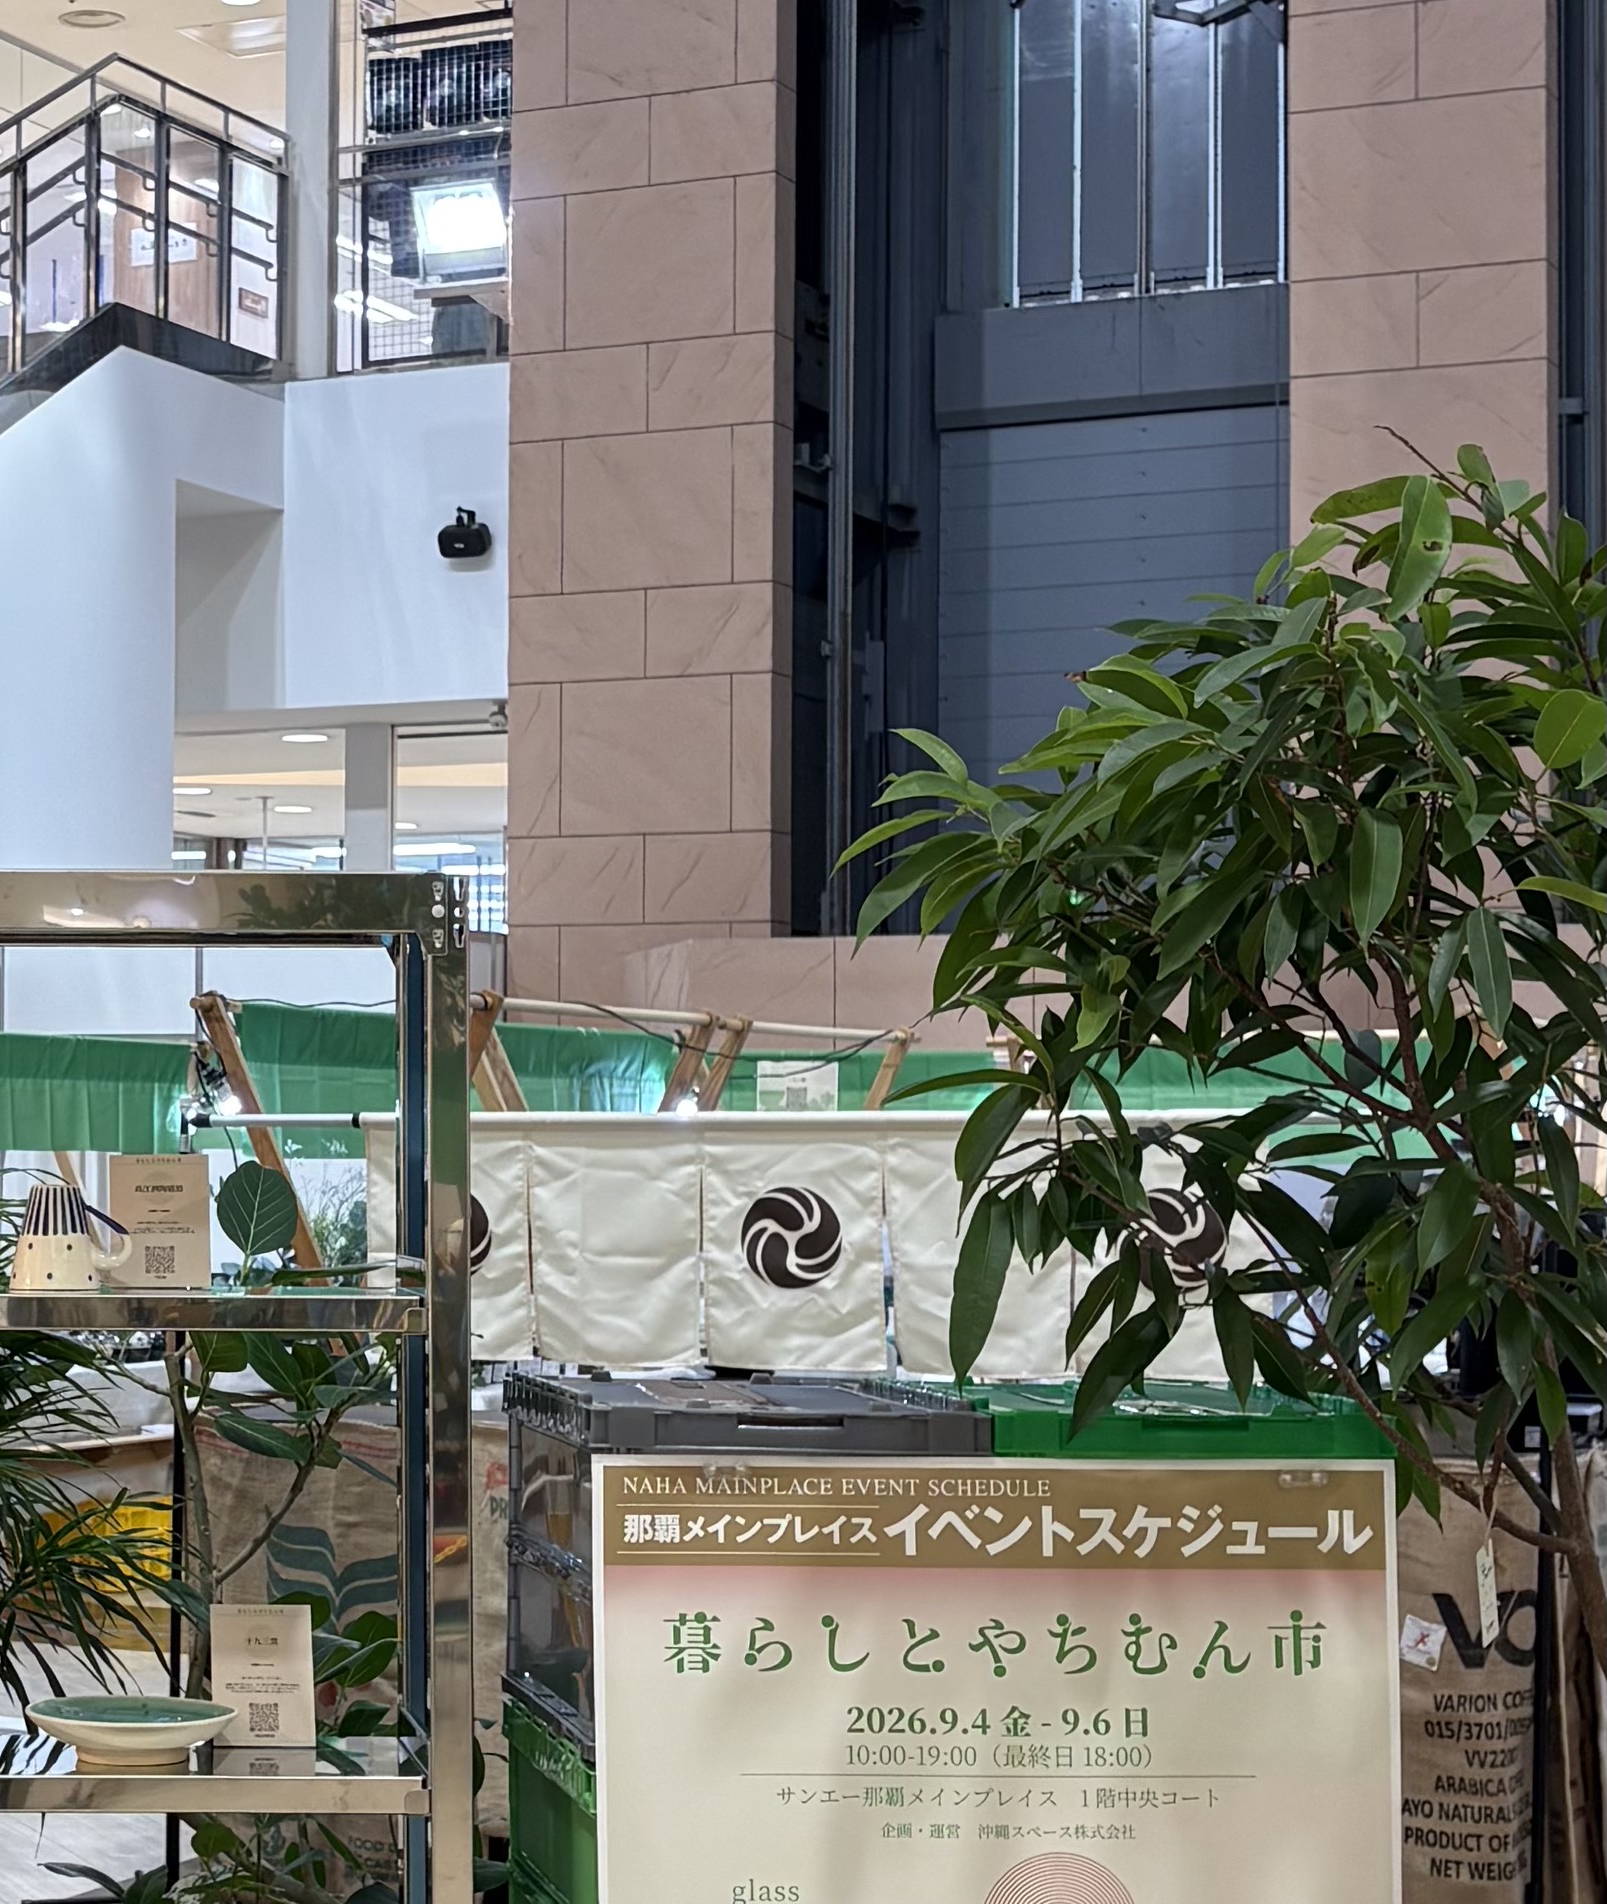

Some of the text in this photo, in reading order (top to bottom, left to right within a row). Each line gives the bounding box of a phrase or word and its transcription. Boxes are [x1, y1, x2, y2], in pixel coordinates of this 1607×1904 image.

[622, 1477, 1052, 1498] NAHA MAINPLACE EVENT SCHEDULE
[623, 1504, 1373, 1557] 那覇メインプレイス イベントスケジュール
[662, 1609, 1328, 1680] 暮らしとやちむん市
[1433, 1693, 1498, 1713] VARION
[845, 1705, 991, 1736] 2026.9.4
[1000, 1704, 1032, 1738] 金
[1061, 1706, 1111, 1736] 9.6
[1124, 1707, 1149, 1738] 日
[845, 1745, 978, 1767] 10:00-19:00
[776, 1786, 1220, 1809] サンエー那覇メインプレイス 1階中央コート
[1435, 1775, 1508, 1798] ARABICA
[1438, 1802, 1512, 1825] NATURAL
[881, 1821, 1137, 1840] 企画・運営 沖縄スペース株式会社
[1404, 1827, 1511, 1854] PRODUCT OF
[1430, 1857, 1517, 1882] NET WEIG
